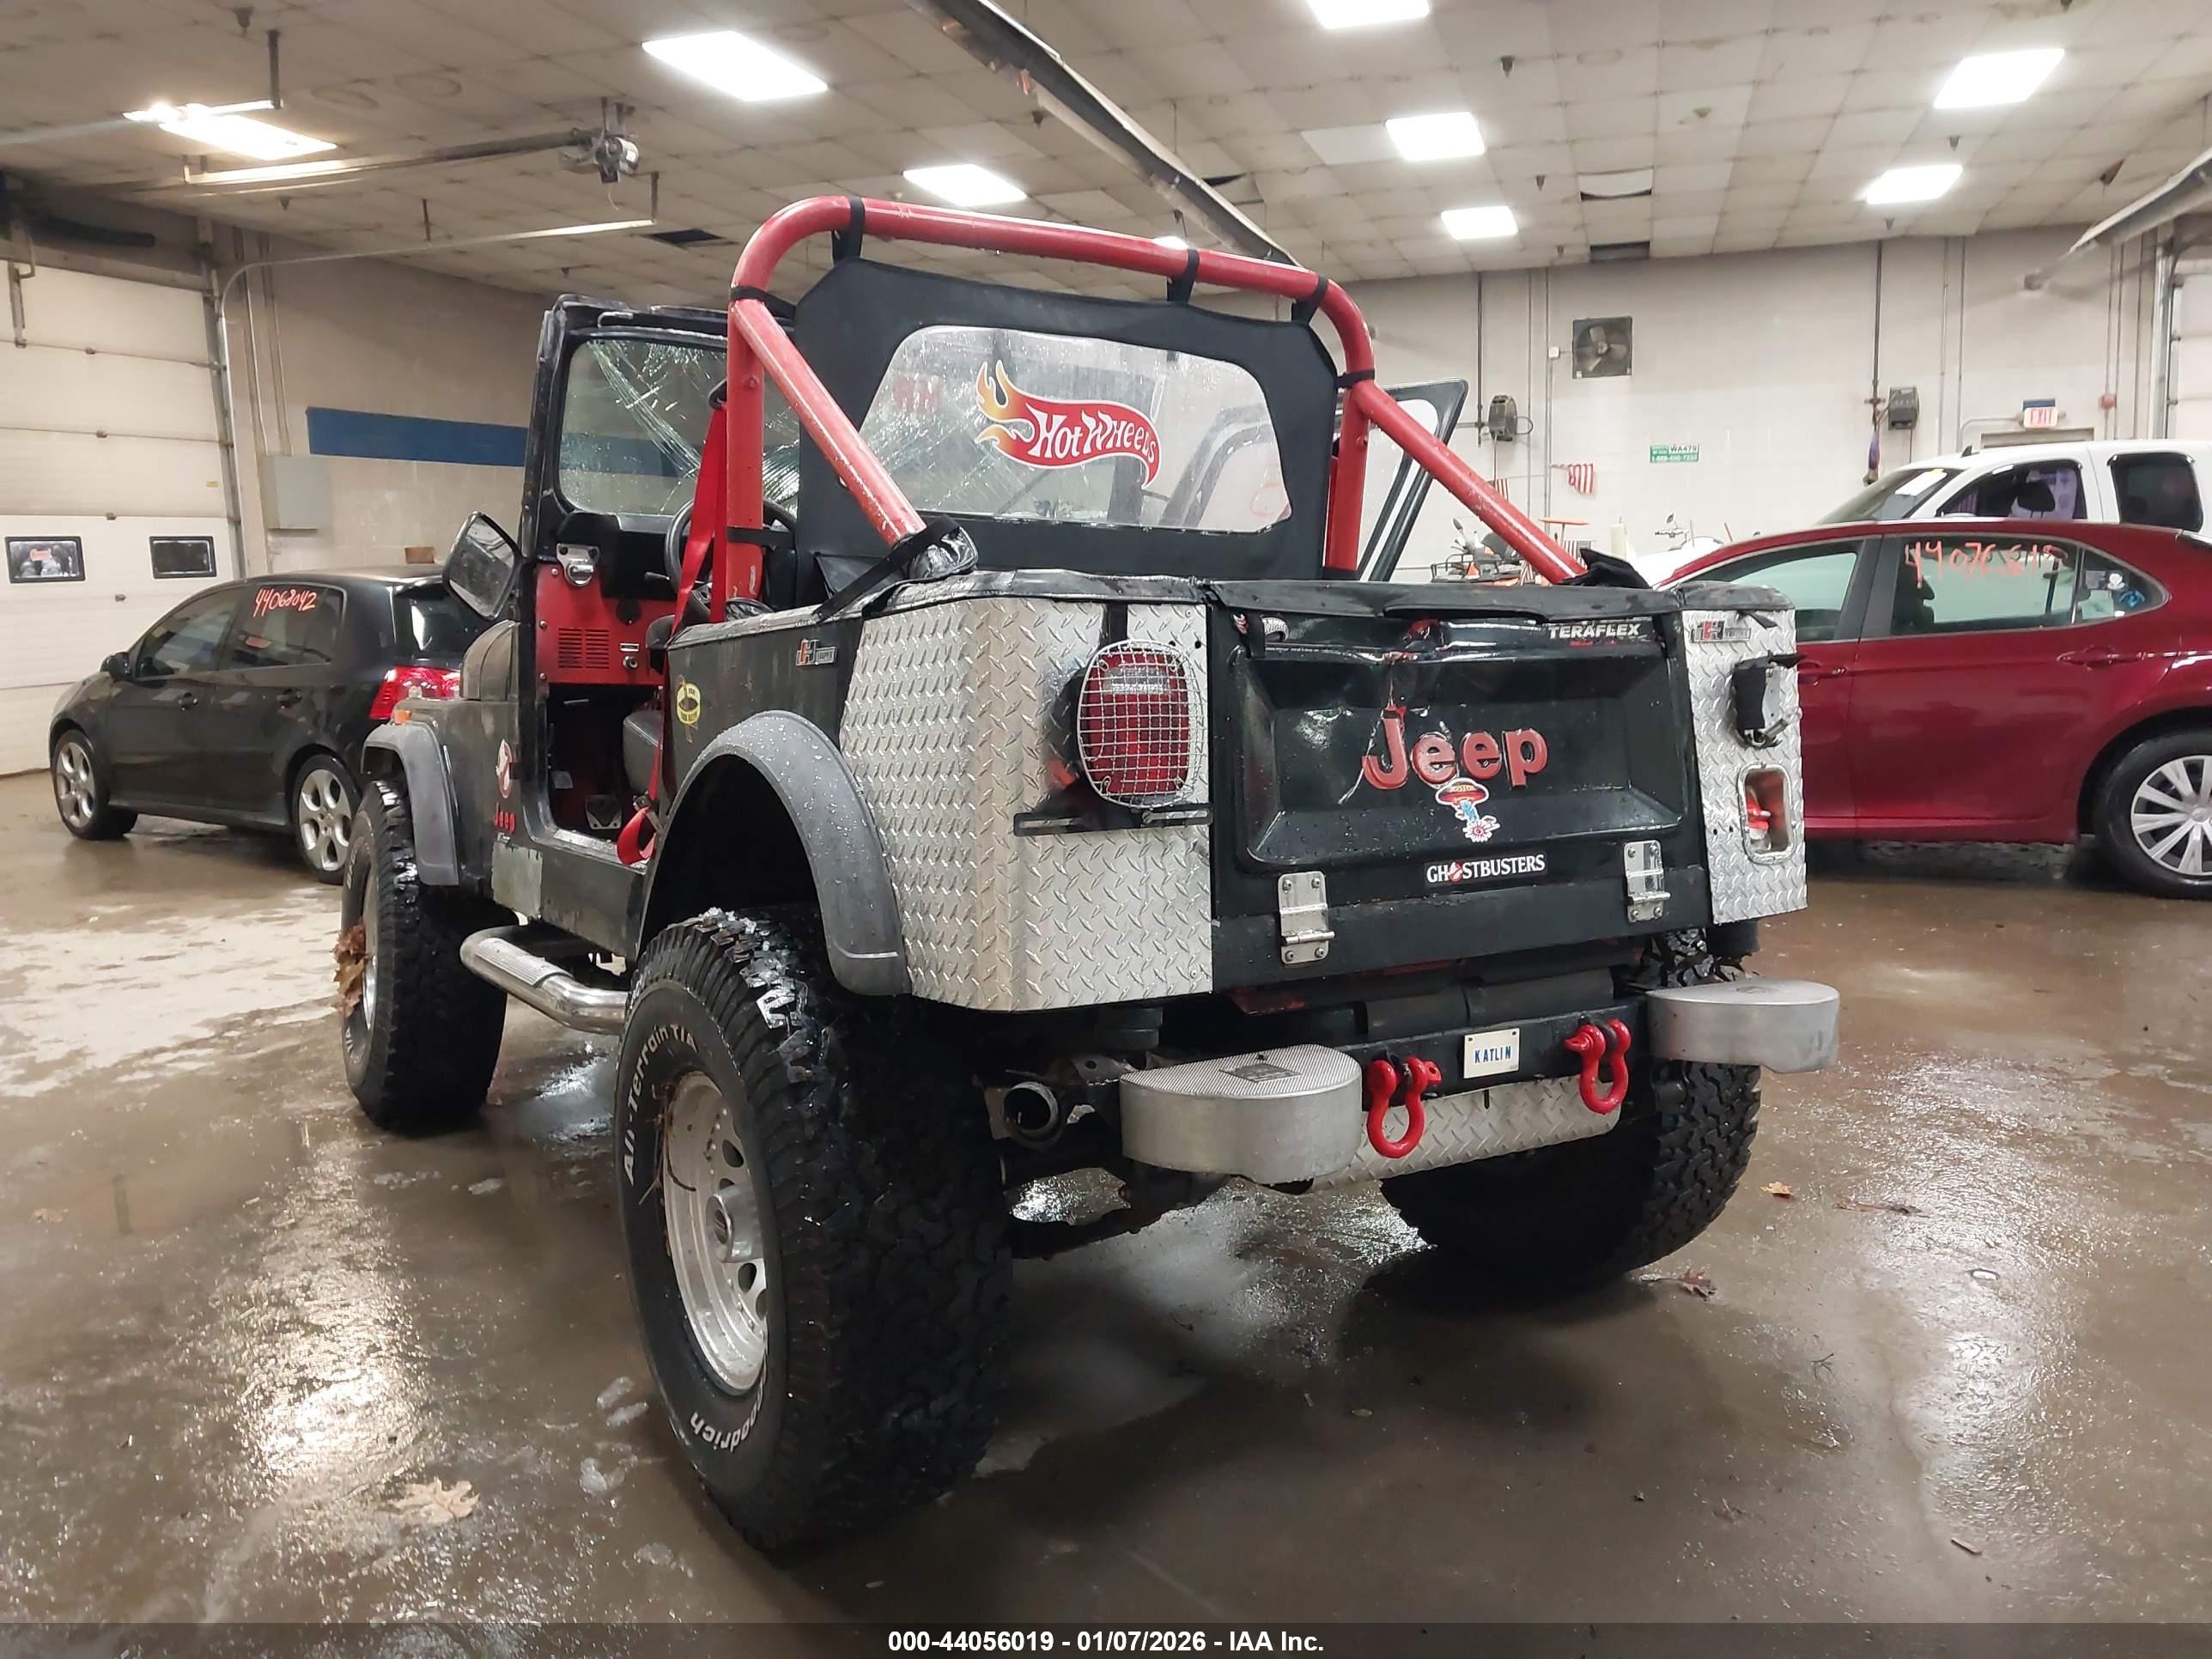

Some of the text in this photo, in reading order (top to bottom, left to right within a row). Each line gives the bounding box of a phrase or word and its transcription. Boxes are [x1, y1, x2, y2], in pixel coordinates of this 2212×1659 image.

[252, 587, 317, 617] 44068042
[1547, 623, 1642, 639] TERAFLEX
[1362, 709, 1548, 790] Jeep
[1474, 1045, 1511, 1064] KATLIN
